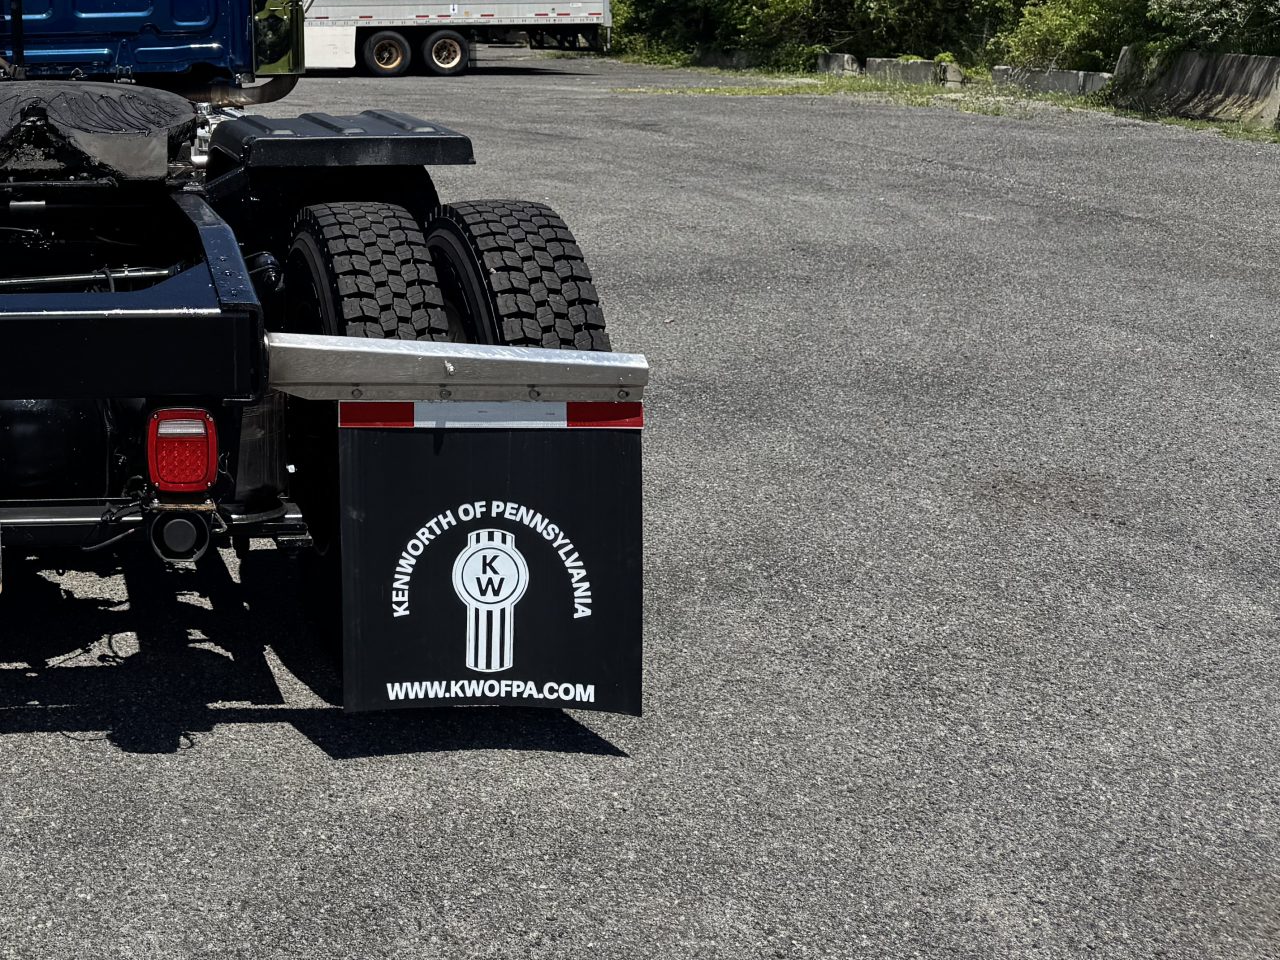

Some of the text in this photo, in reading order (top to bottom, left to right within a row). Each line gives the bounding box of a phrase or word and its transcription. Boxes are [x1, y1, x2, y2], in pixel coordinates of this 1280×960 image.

[392, 501, 593, 619] KENWORTH OF PENNSYLVANIA
[387, 680, 595, 703] WWW.KWOFPA.COM
